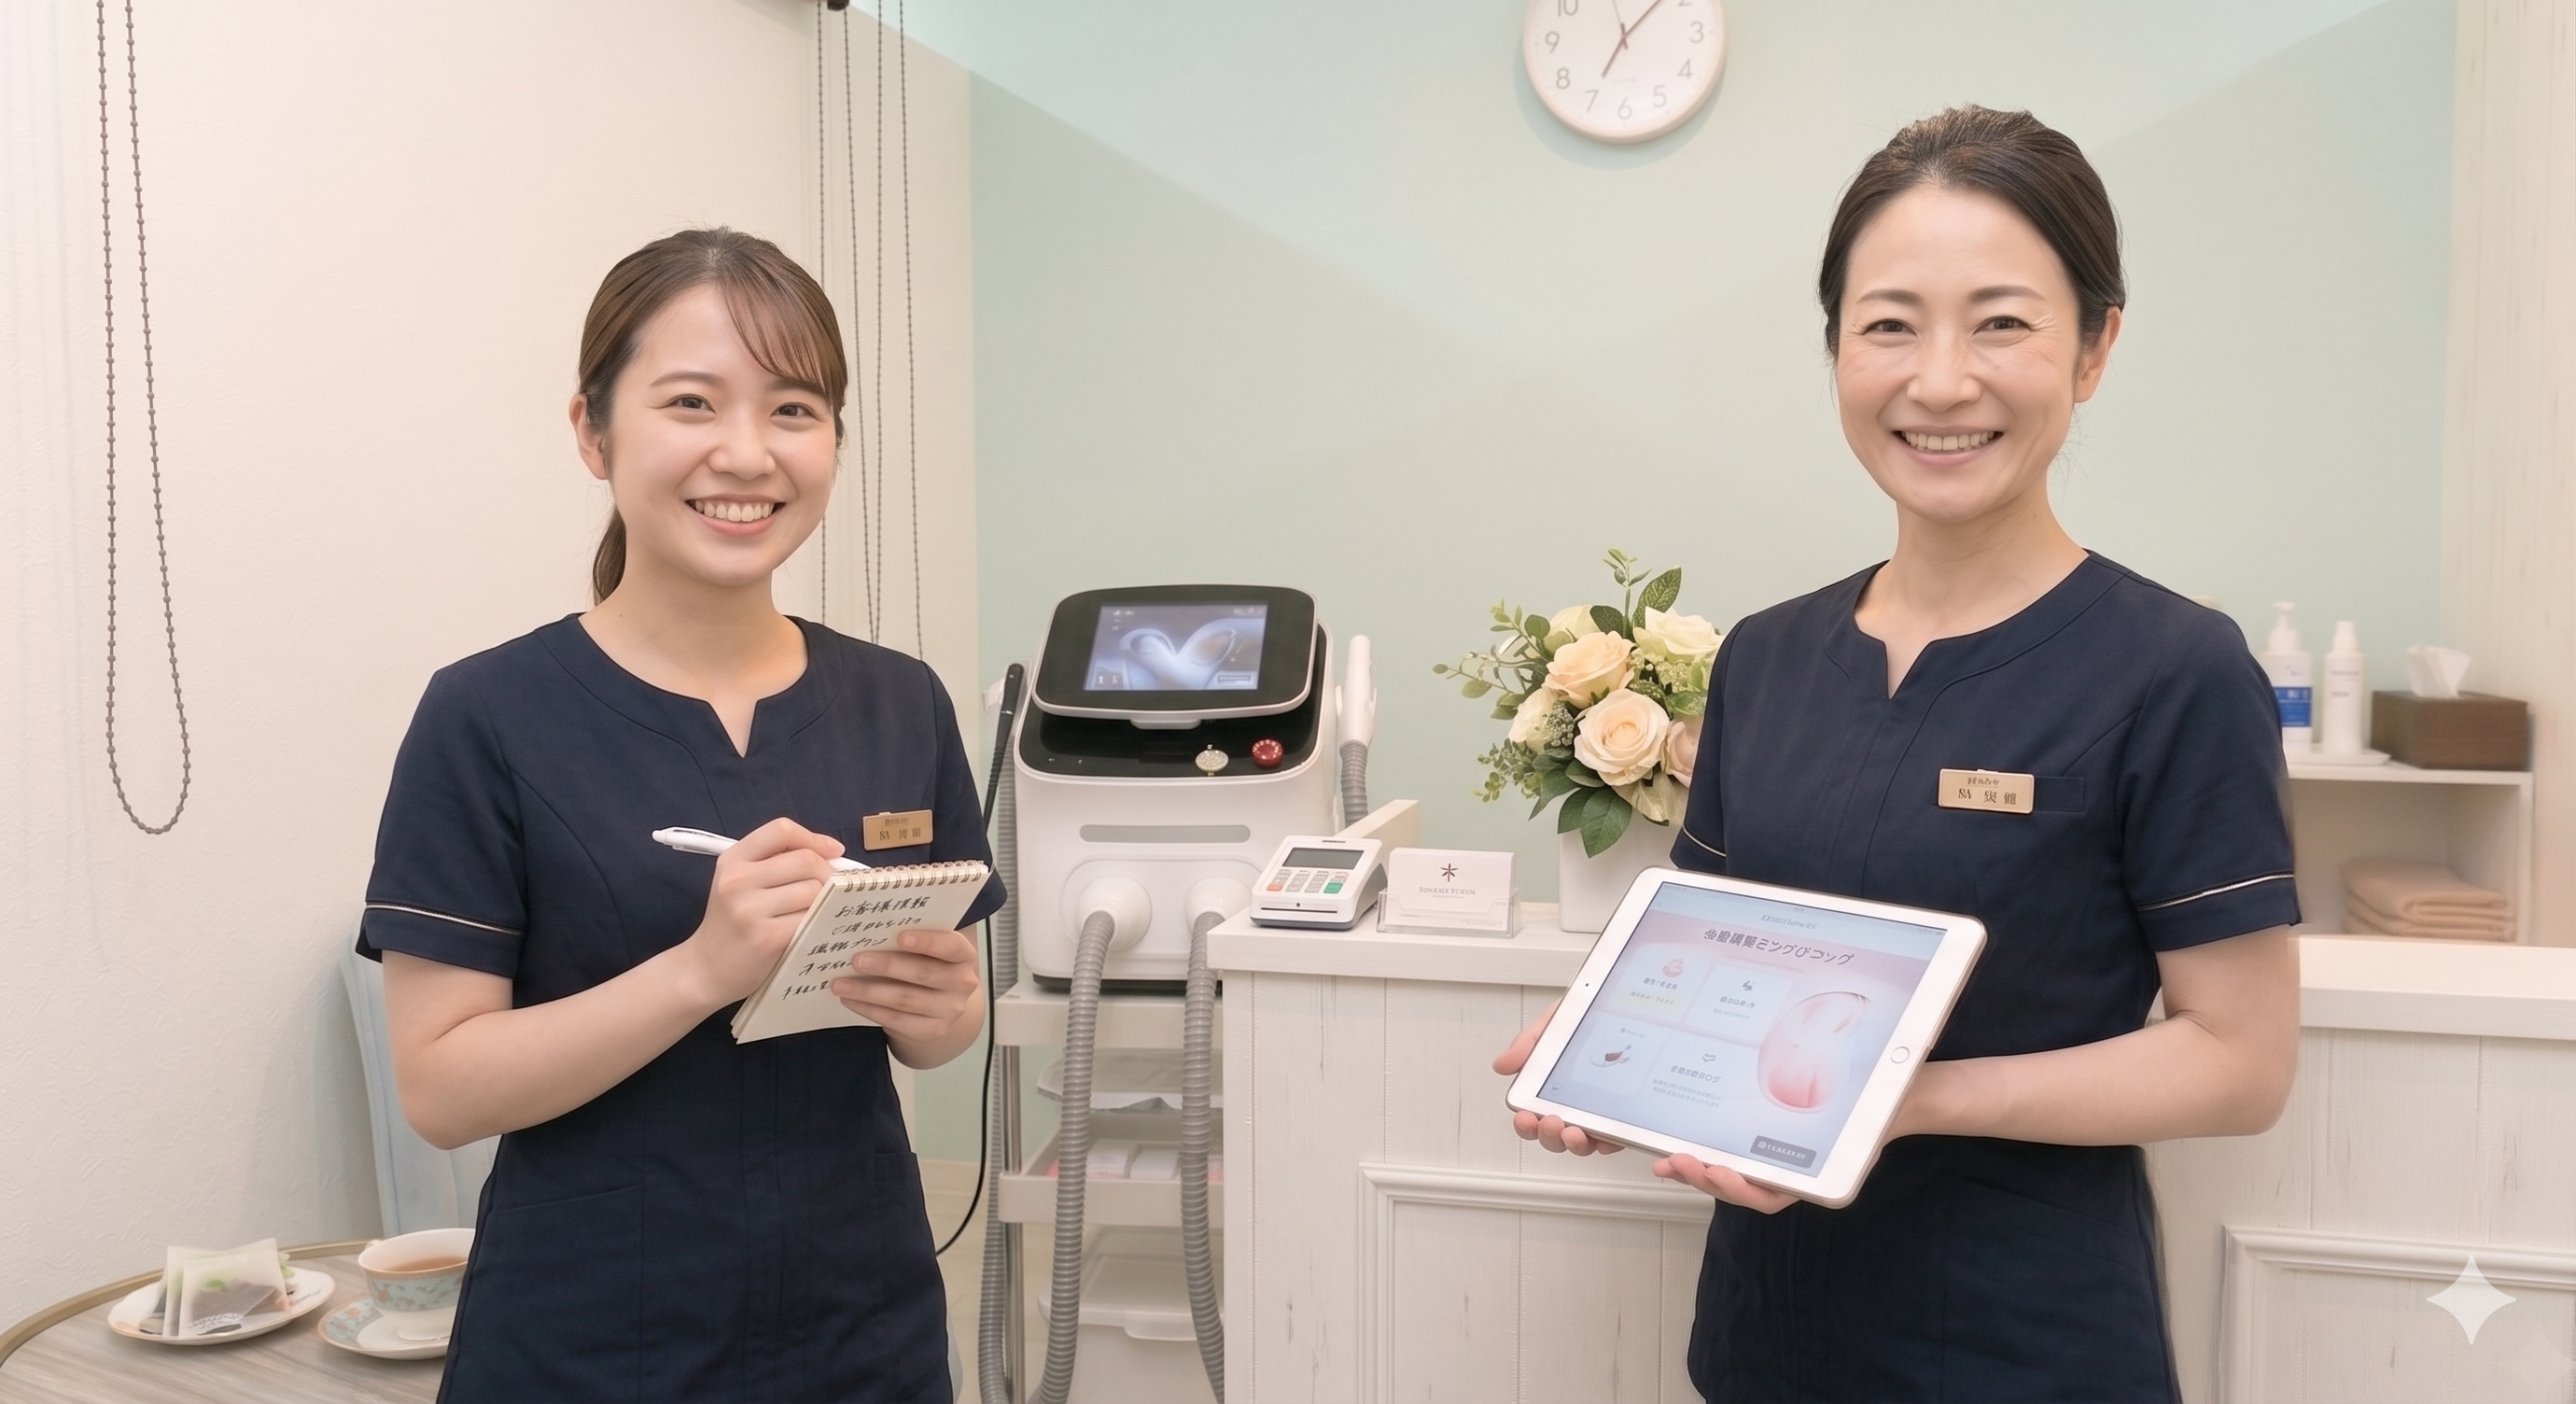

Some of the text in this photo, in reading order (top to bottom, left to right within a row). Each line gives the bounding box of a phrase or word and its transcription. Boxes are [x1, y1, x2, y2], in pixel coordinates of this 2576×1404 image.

[1558, 0, 1578, 17] 10
[1545, 31, 1561, 54] 9
[1689, 21, 1704, 44] 3
[1555, 67, 1571, 90] 8
[1677, 58, 1693, 80] 4
[1585, 89, 1599, 113] 7
[1652, 84, 1667, 108] 5
[1617, 97, 1632, 120] 6
